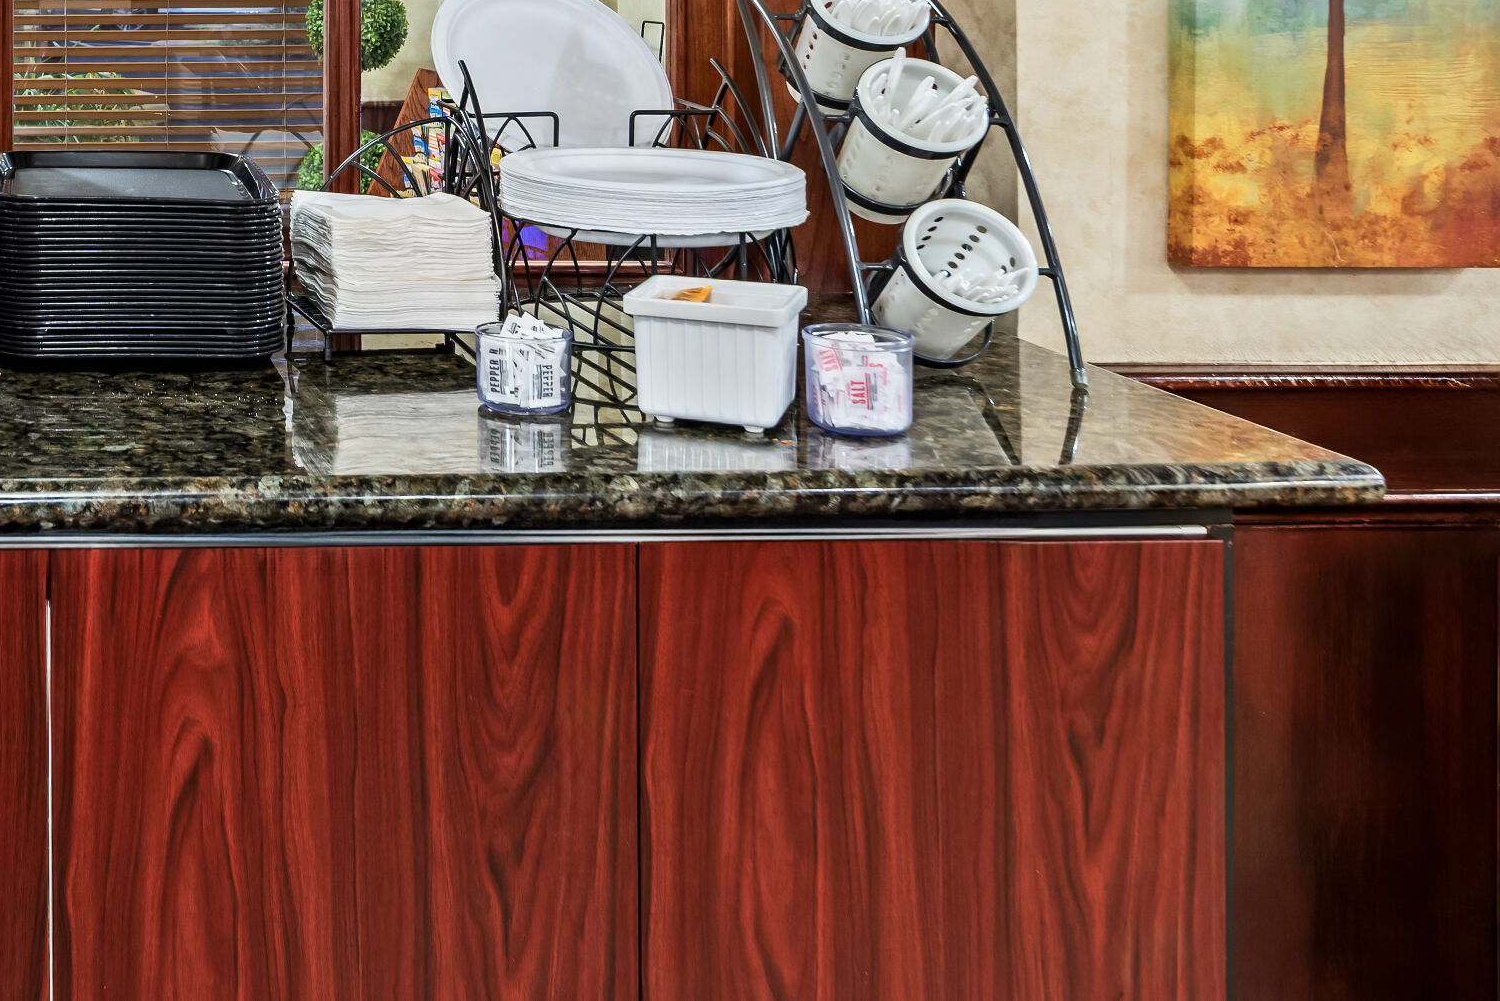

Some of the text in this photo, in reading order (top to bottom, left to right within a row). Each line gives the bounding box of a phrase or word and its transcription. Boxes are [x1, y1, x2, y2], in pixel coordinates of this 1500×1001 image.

[818, 349, 839, 372] SALT
[489, 359, 501, 394] PEPPER
[542, 364, 554, 398] PEPPER
[850, 379, 866, 405] SALT
